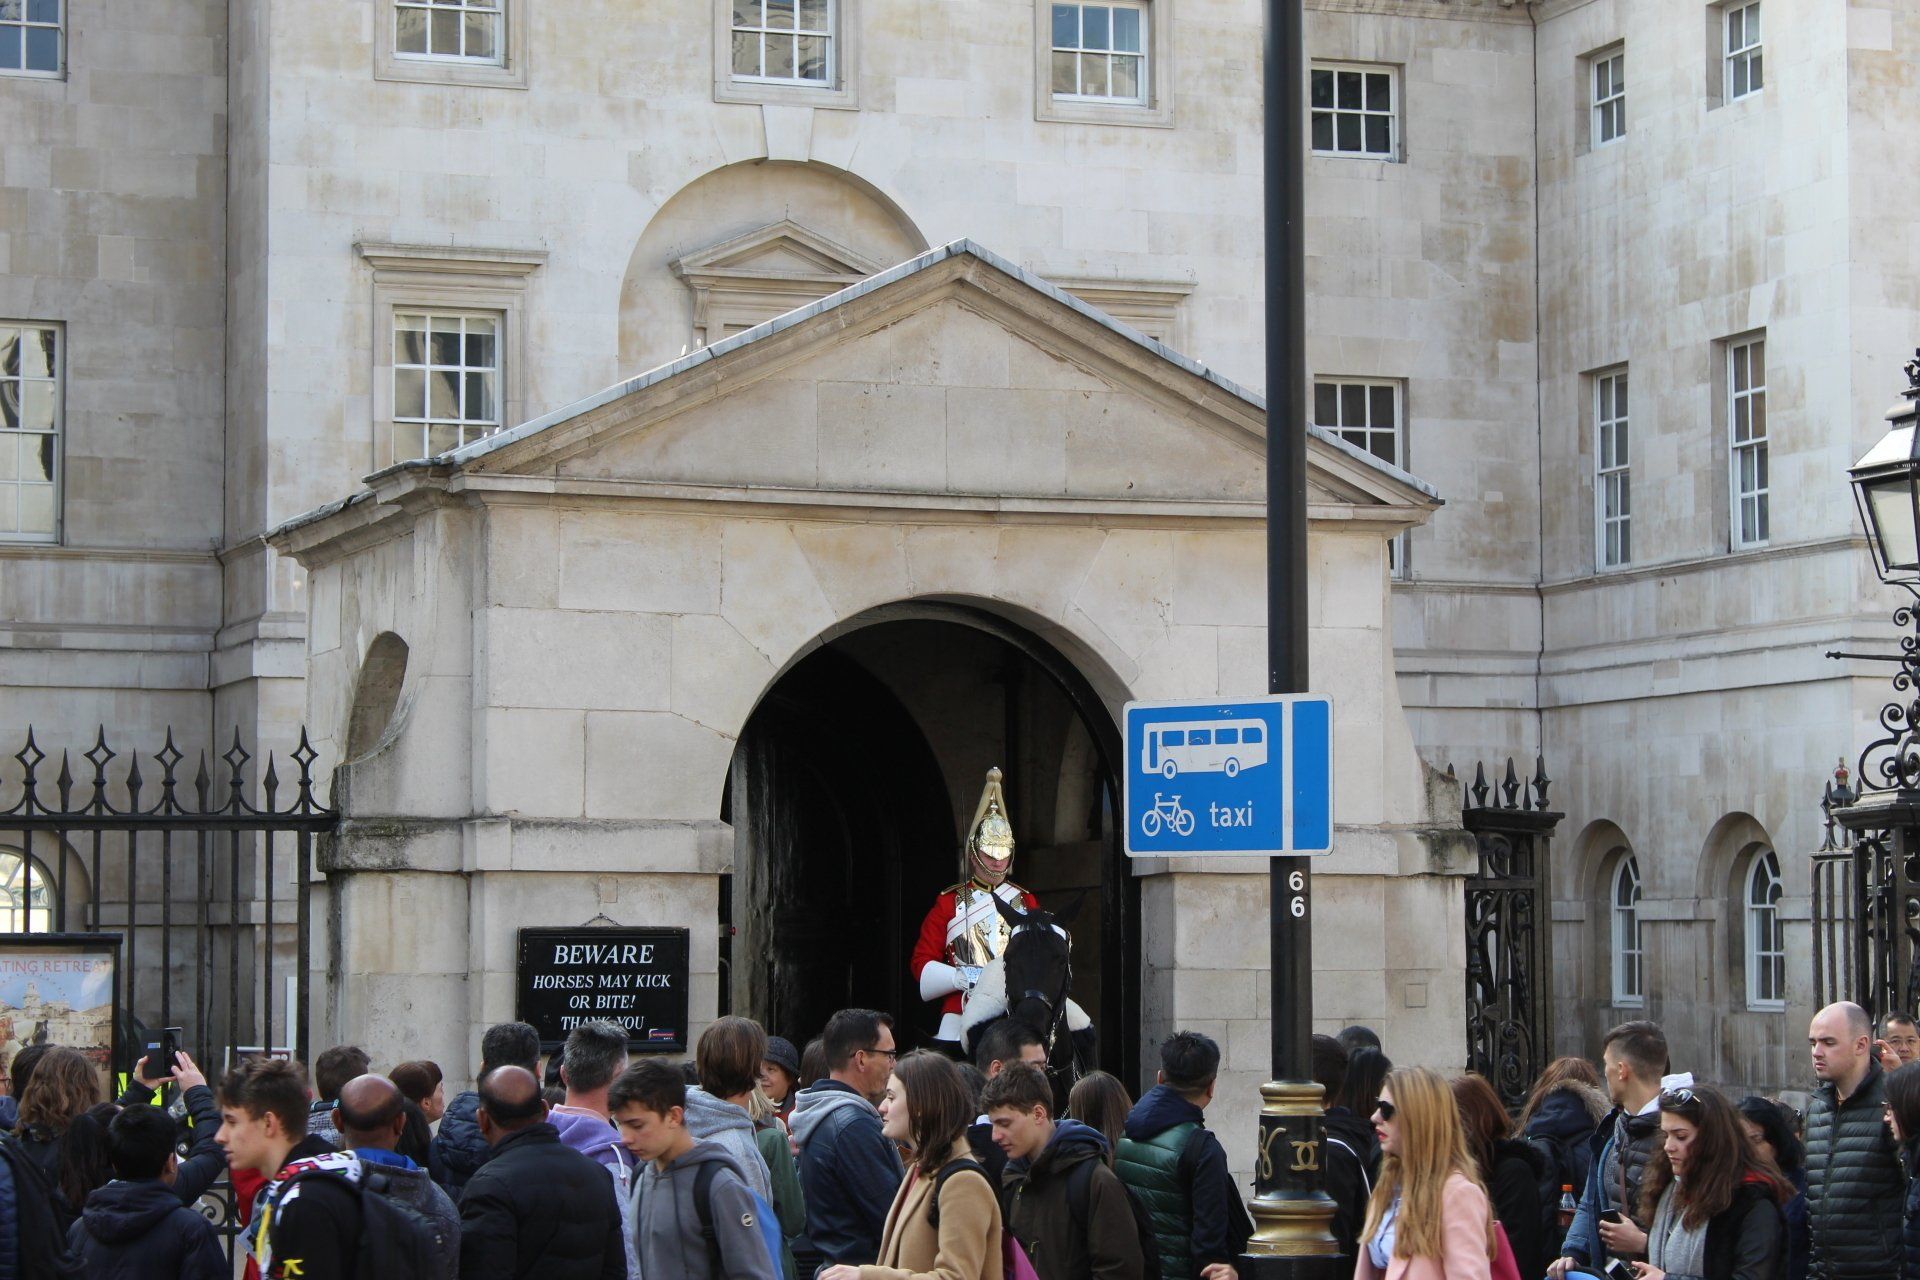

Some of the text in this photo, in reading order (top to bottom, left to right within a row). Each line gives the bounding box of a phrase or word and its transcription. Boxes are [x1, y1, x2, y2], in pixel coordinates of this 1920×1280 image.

[1209, 800, 1252, 827] taxi
[553, 944, 654, 965] BEWARE
[0, 960, 110, 972] TING RETREAT
[533, 974, 671, 989] HORSES MAY KICK
[569, 995, 636, 1009] OR BITE!
[617, 1016, 645, 1030] YOU
